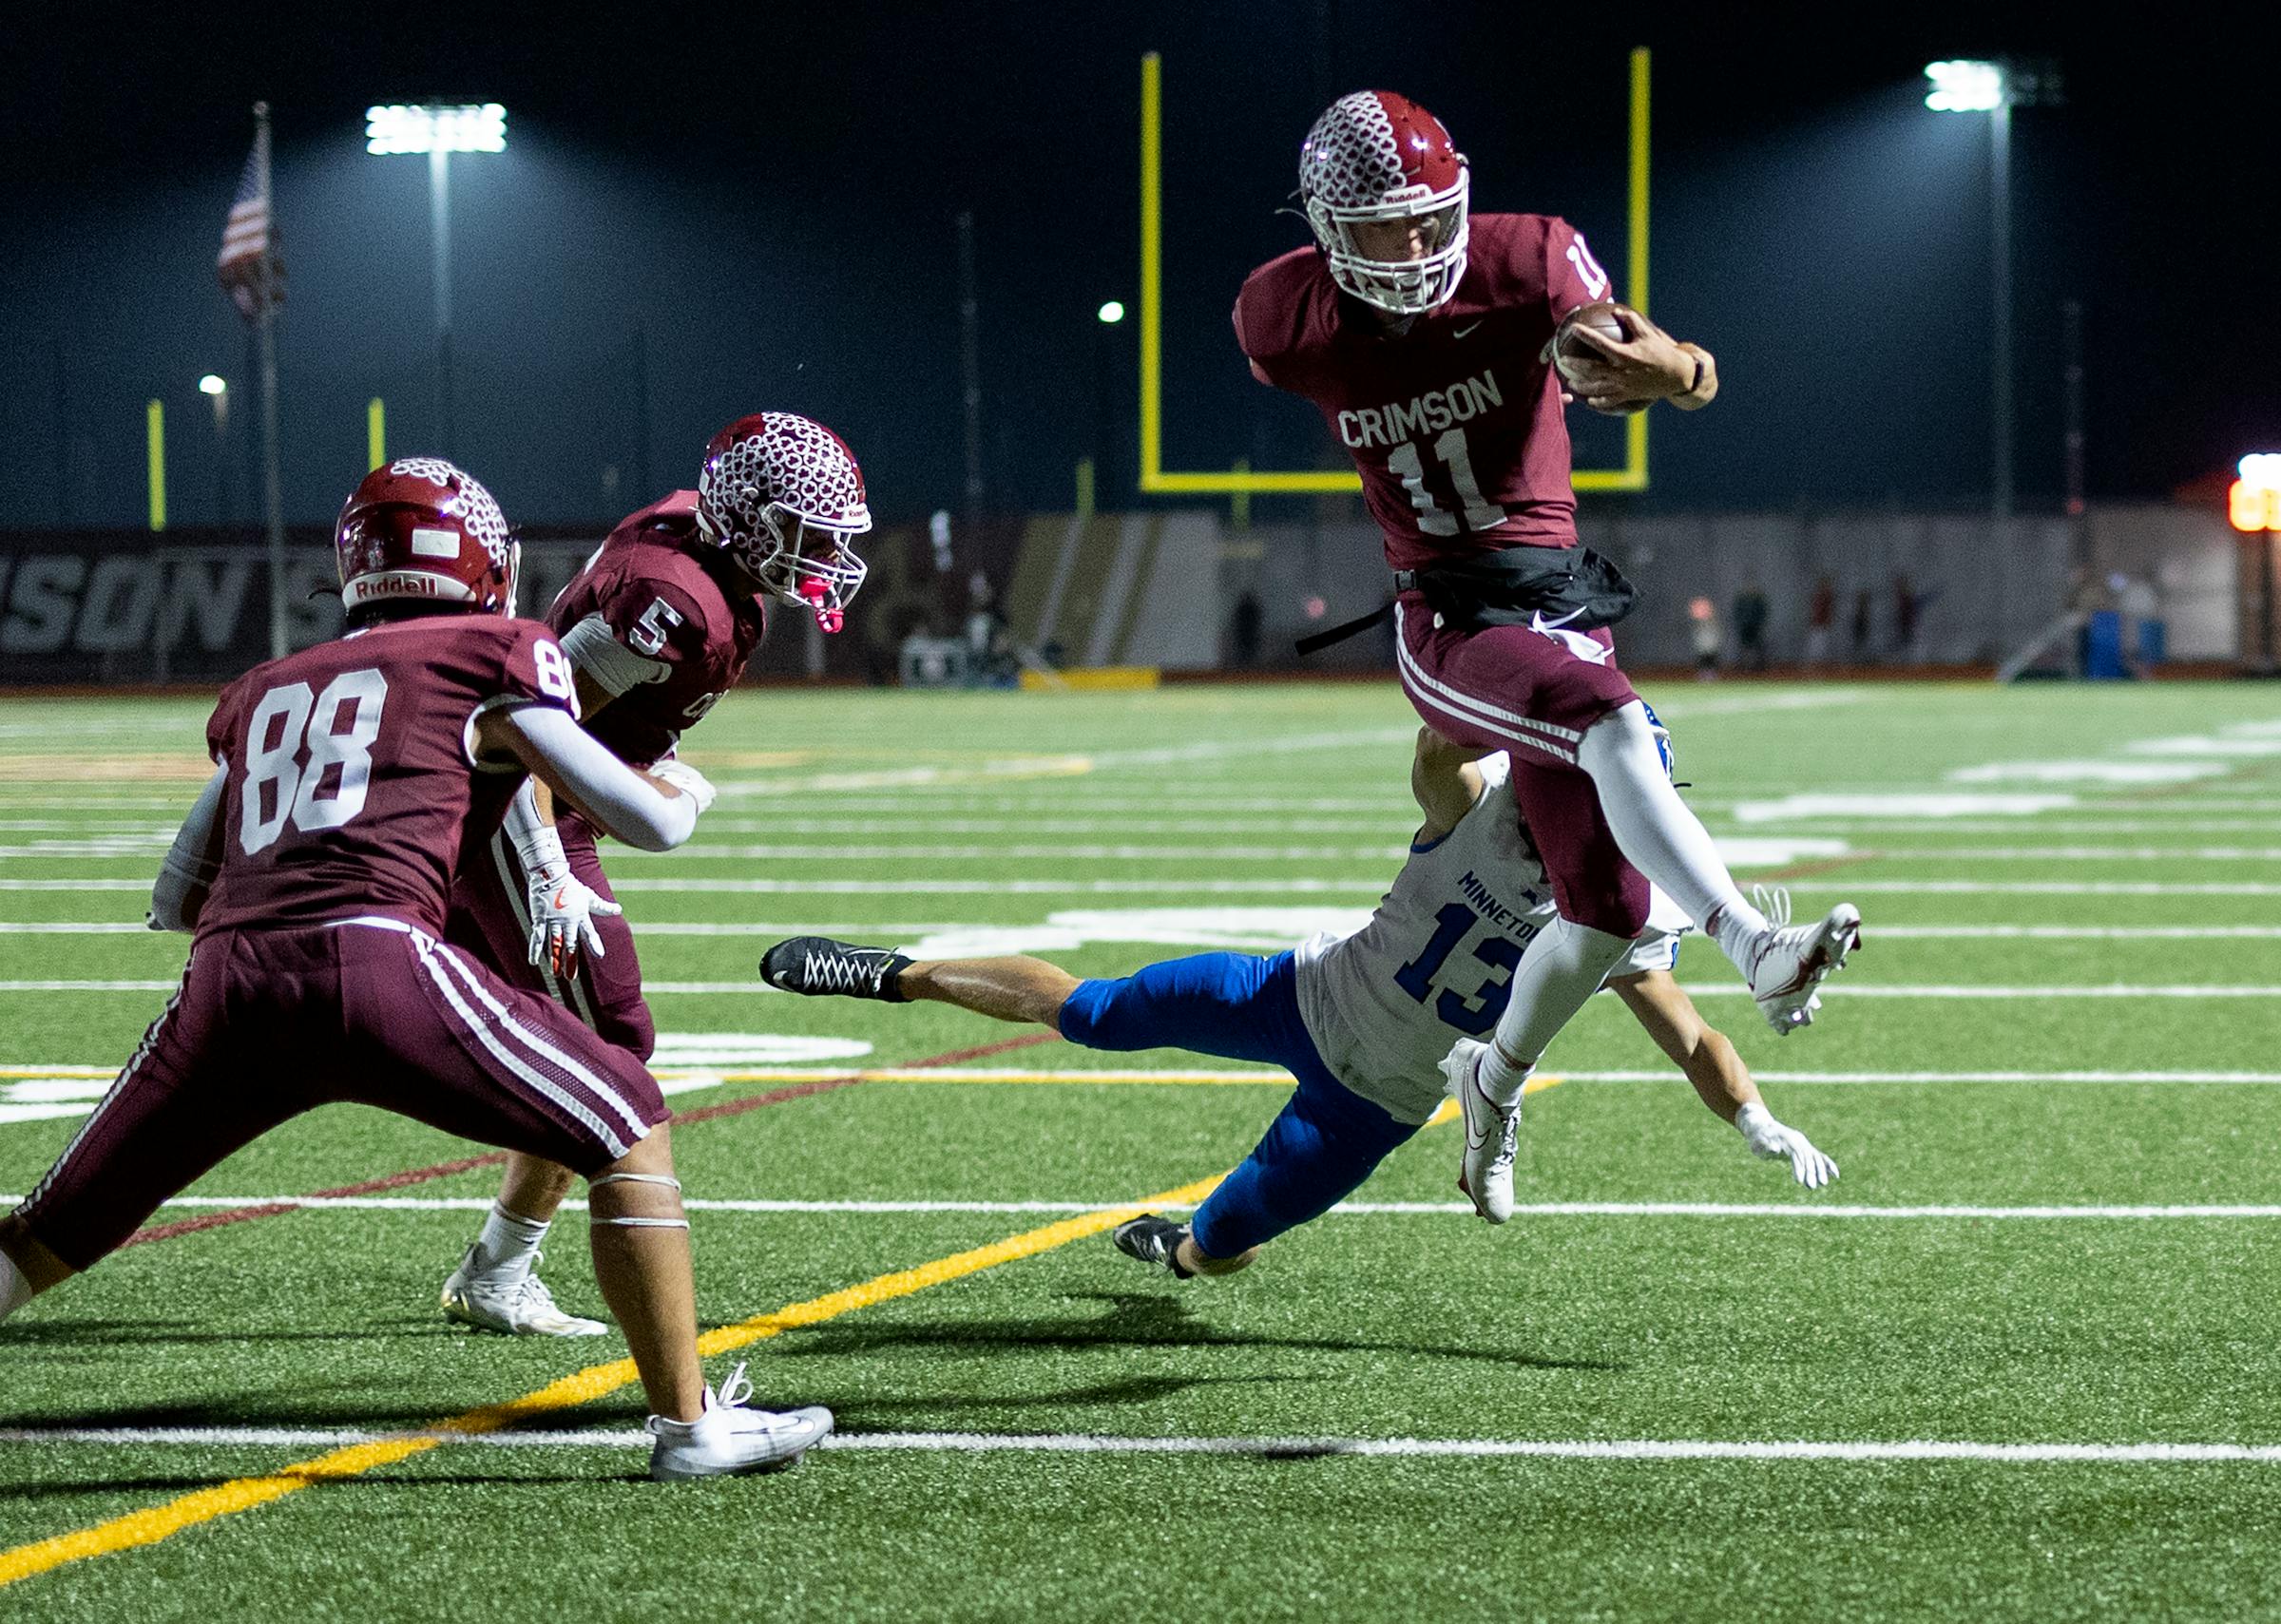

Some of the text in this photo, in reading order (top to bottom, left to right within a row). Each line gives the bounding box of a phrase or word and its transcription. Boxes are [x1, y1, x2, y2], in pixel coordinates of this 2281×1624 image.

[1338, 369, 1504, 449] CRIMSON
[1388, 427, 1508, 537] 11
[0, 548, 255, 652] SON
[355, 576, 438, 599] Riddell
[629, 596, 684, 656] 5
[240, 668, 388, 855] 88
[1393, 903, 1525, 1036] 13
